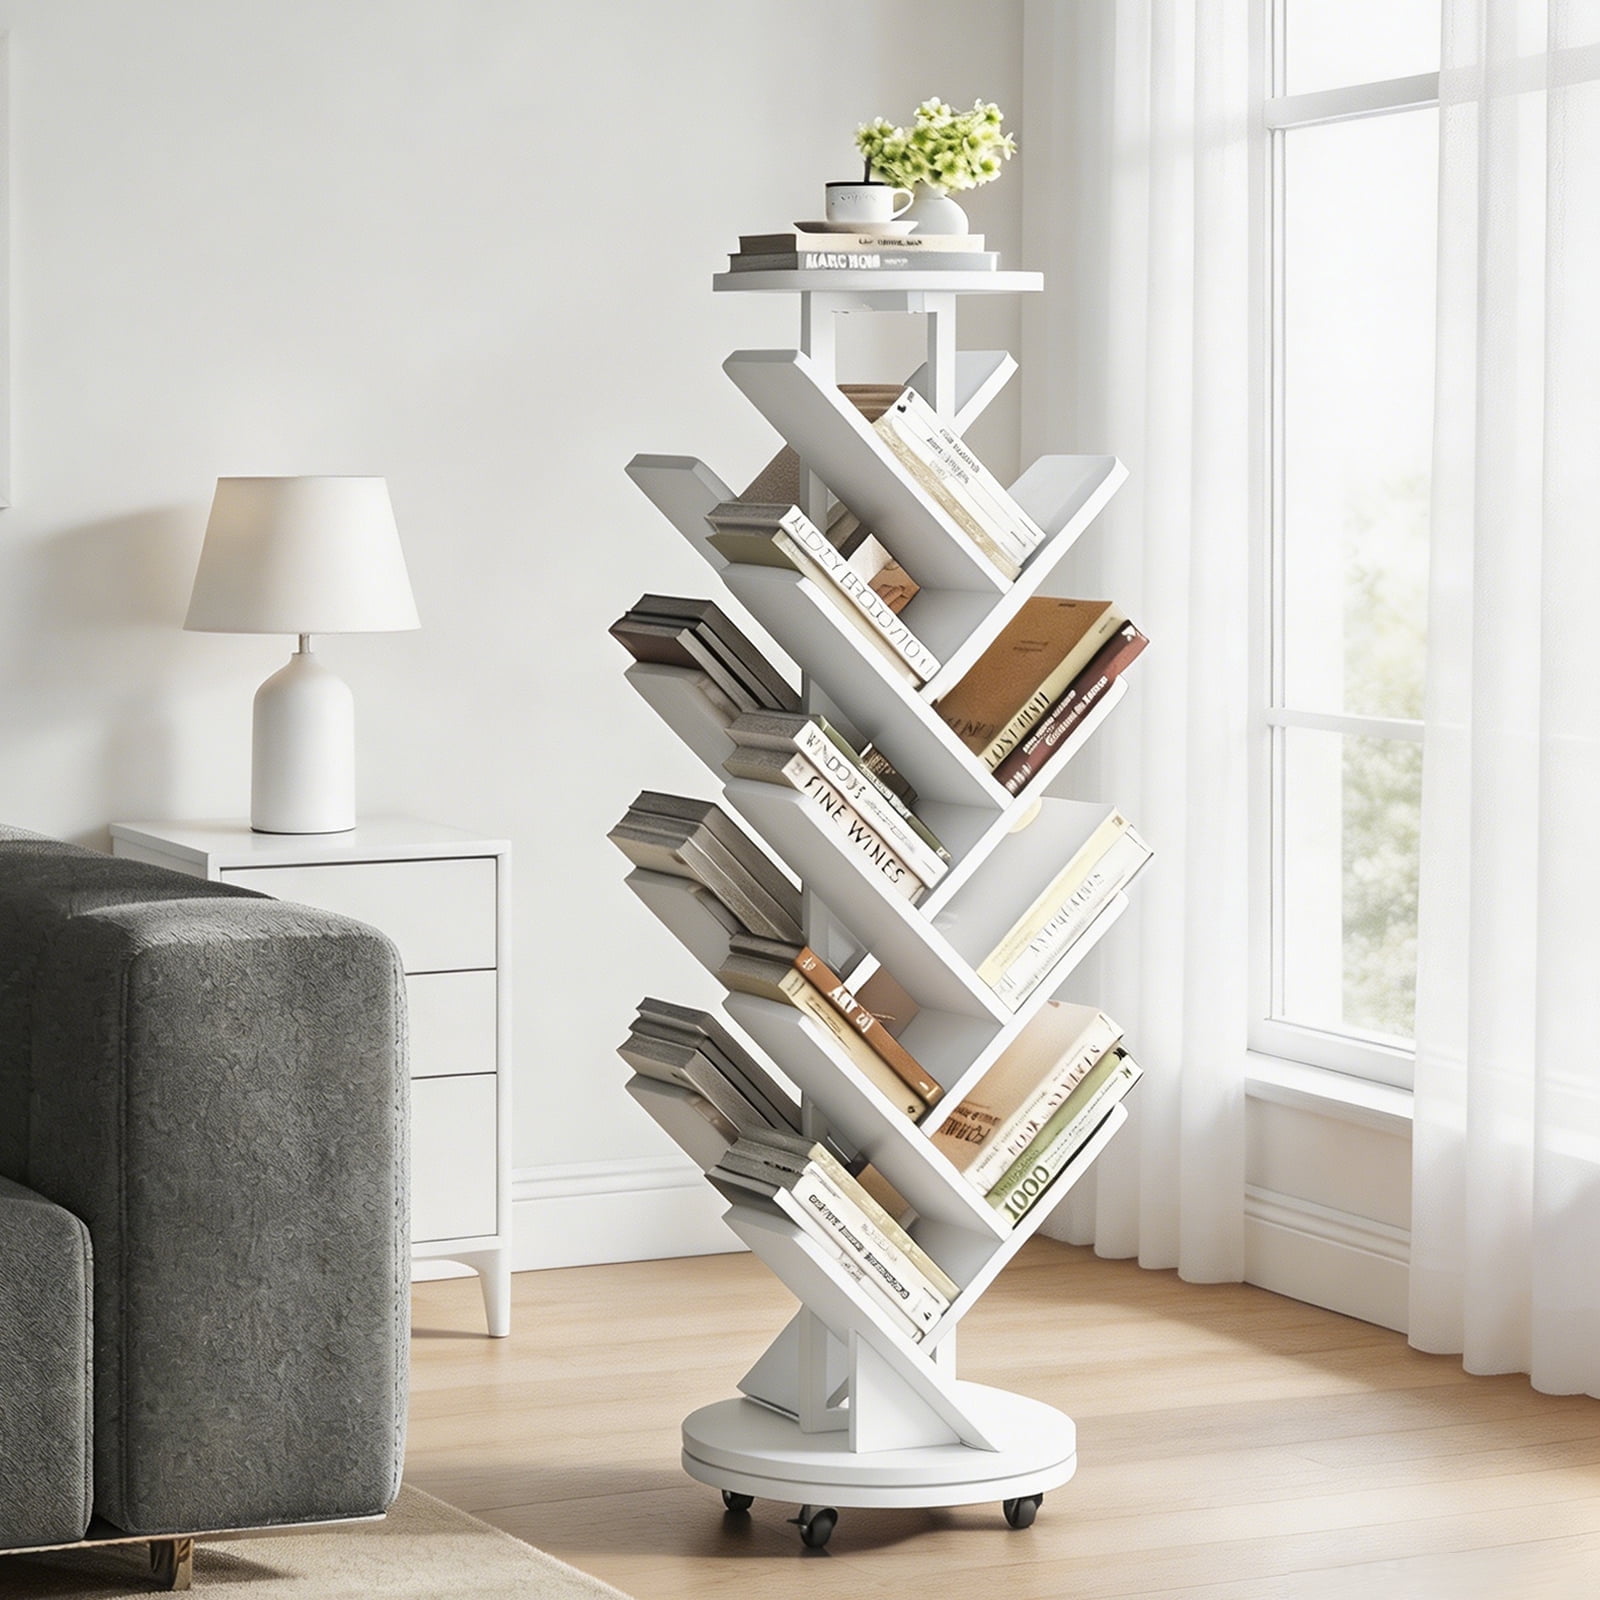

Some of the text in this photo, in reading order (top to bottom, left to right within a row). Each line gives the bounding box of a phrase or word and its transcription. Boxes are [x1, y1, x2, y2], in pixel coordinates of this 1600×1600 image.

[804, 775, 848, 824] FINE
[847, 819, 906, 883] WINES
[1003, 1164, 1050, 1221] 1000
